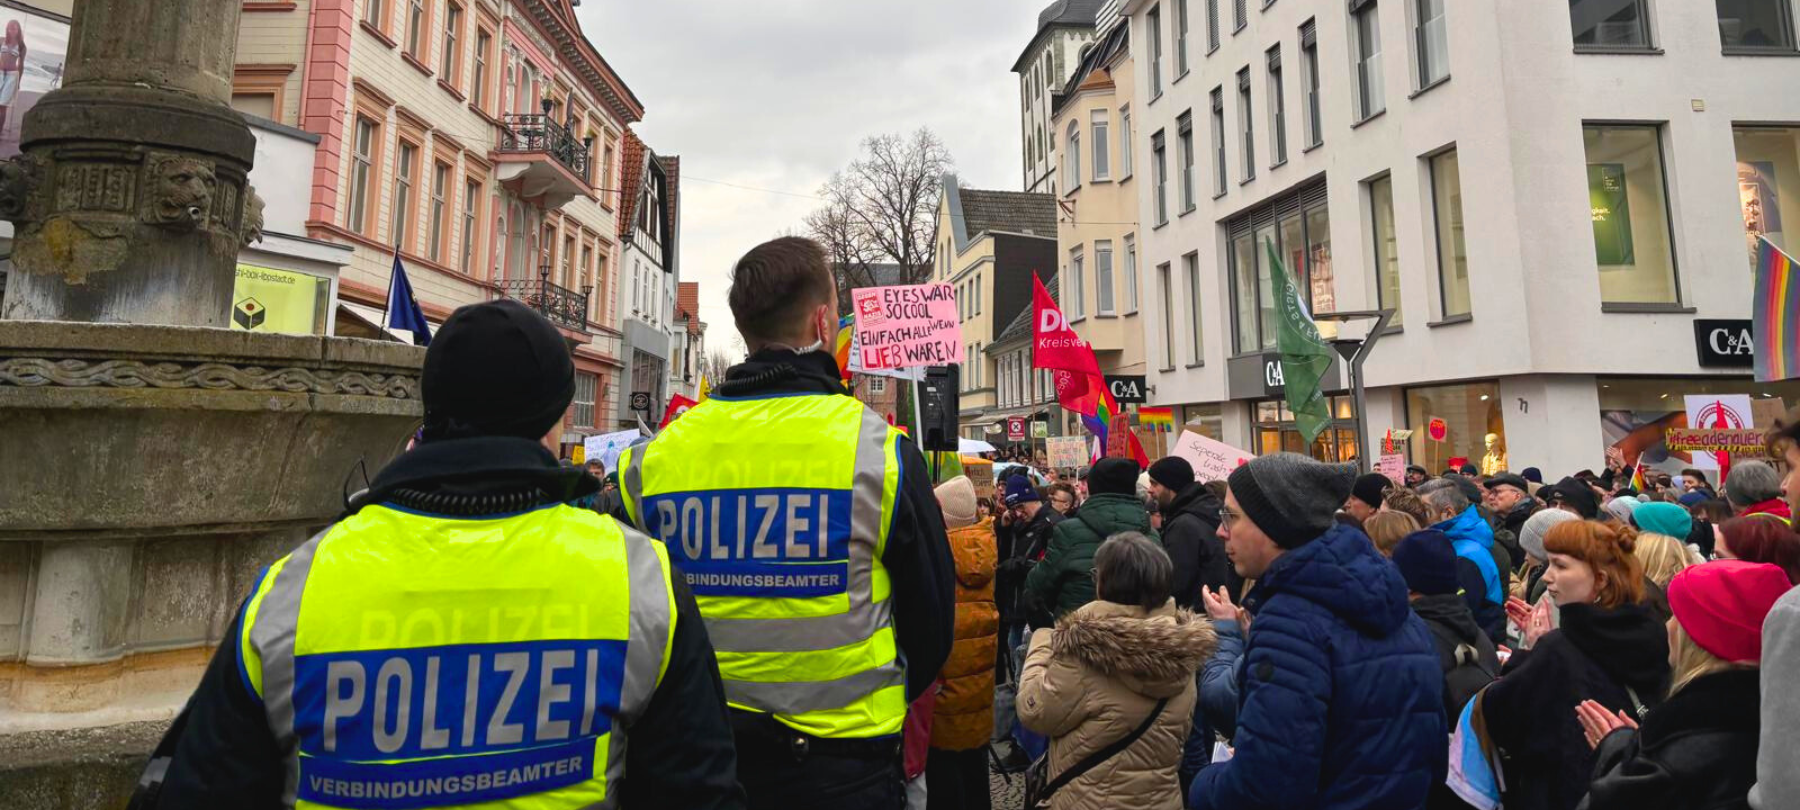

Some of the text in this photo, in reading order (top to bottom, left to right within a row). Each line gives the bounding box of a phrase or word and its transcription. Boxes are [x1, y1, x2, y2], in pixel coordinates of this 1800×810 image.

[861, 327, 914, 346] EINFACH
[1709, 328, 1755, 355] C&A
[1266, 360, 1286, 387] C&A
[1111, 380, 1142, 398] C&A
[656, 494, 829, 561] POLIZEI
[683, 573, 839, 588] BINDUNGSBEAMTER
[323, 648, 599, 753] POLIZEI
[308, 755, 583, 799] VERBINDUNGSBEAMTER
